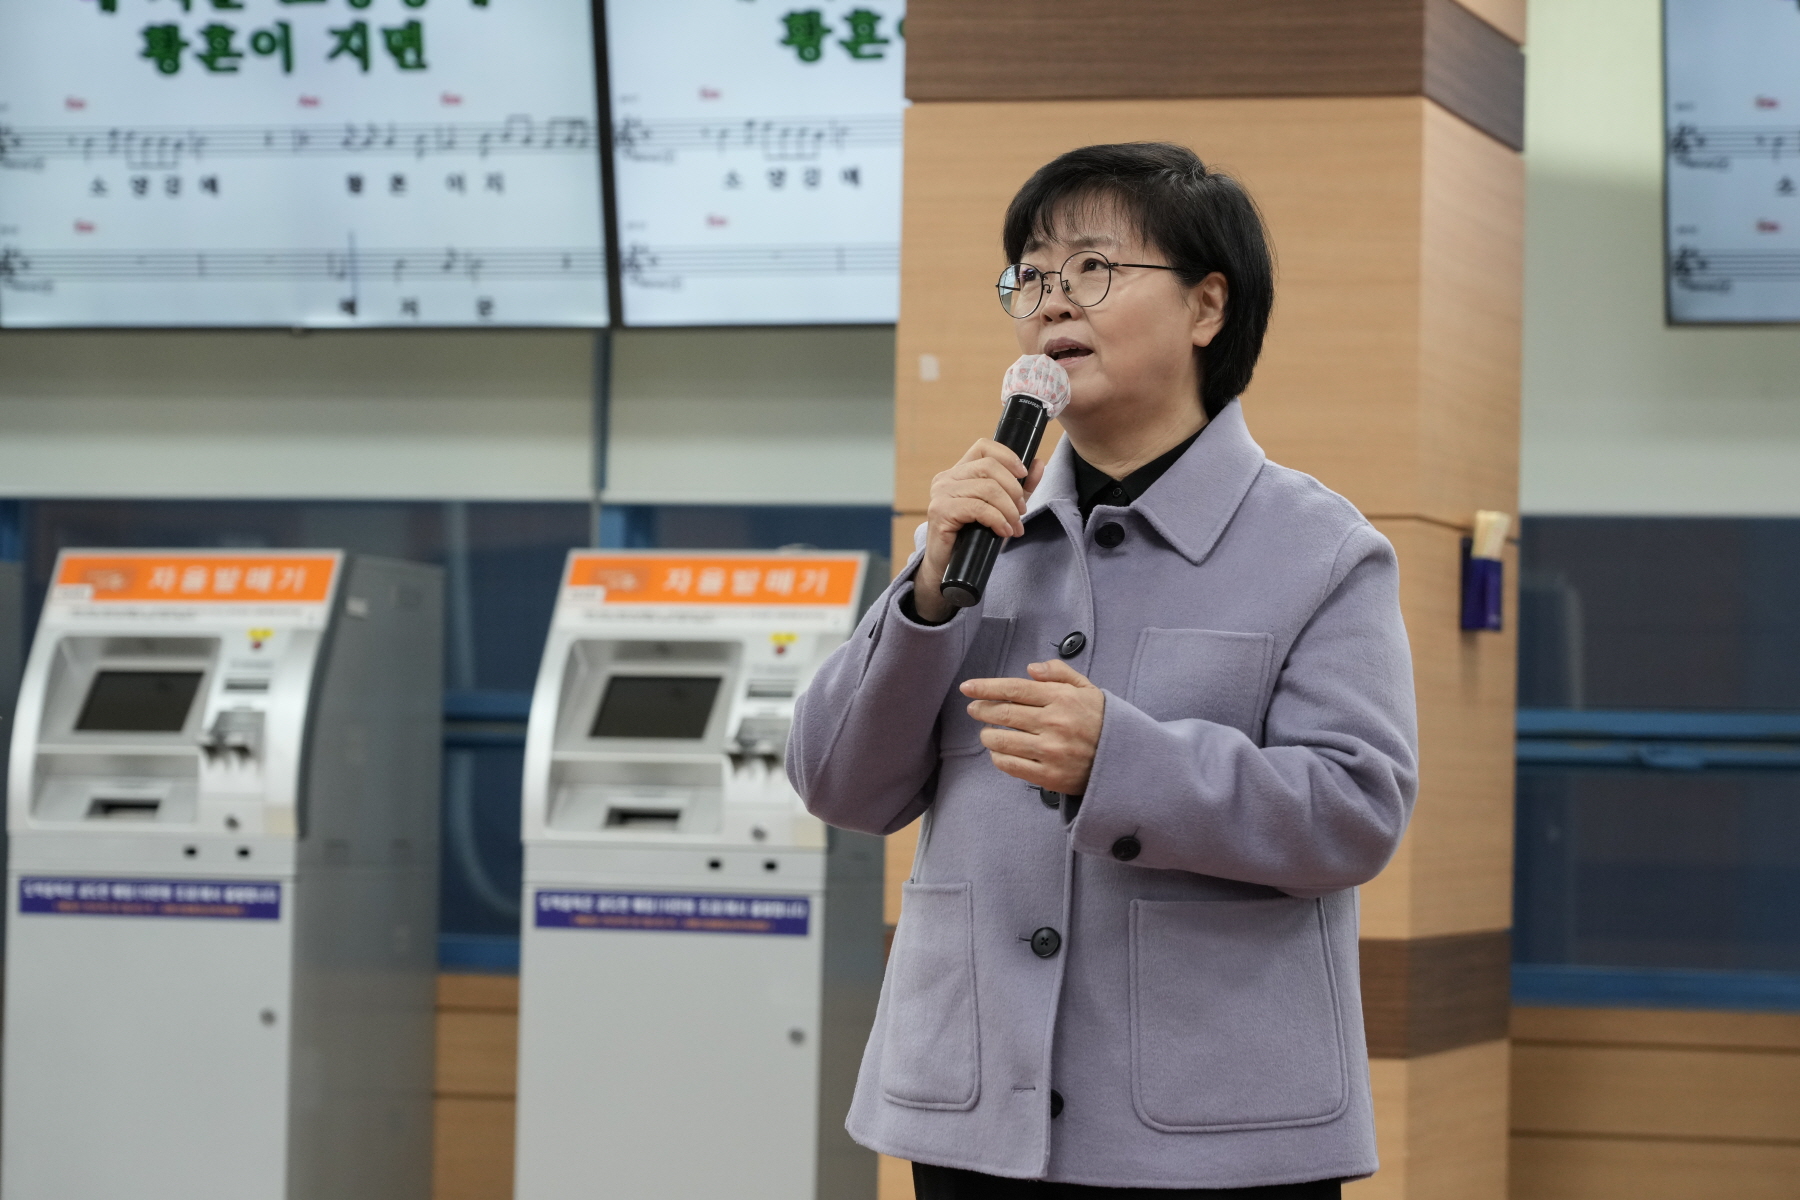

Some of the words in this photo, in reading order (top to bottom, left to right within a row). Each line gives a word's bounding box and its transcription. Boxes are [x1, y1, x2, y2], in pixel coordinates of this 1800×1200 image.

[140, 20, 295, 75] 황혼이
[326, 19, 428, 72] 지면
[779, 9, 906, 62] 황혼
[148, 566, 307, 594] 자율발매기
[662, 566, 830, 596] 자율발매기
